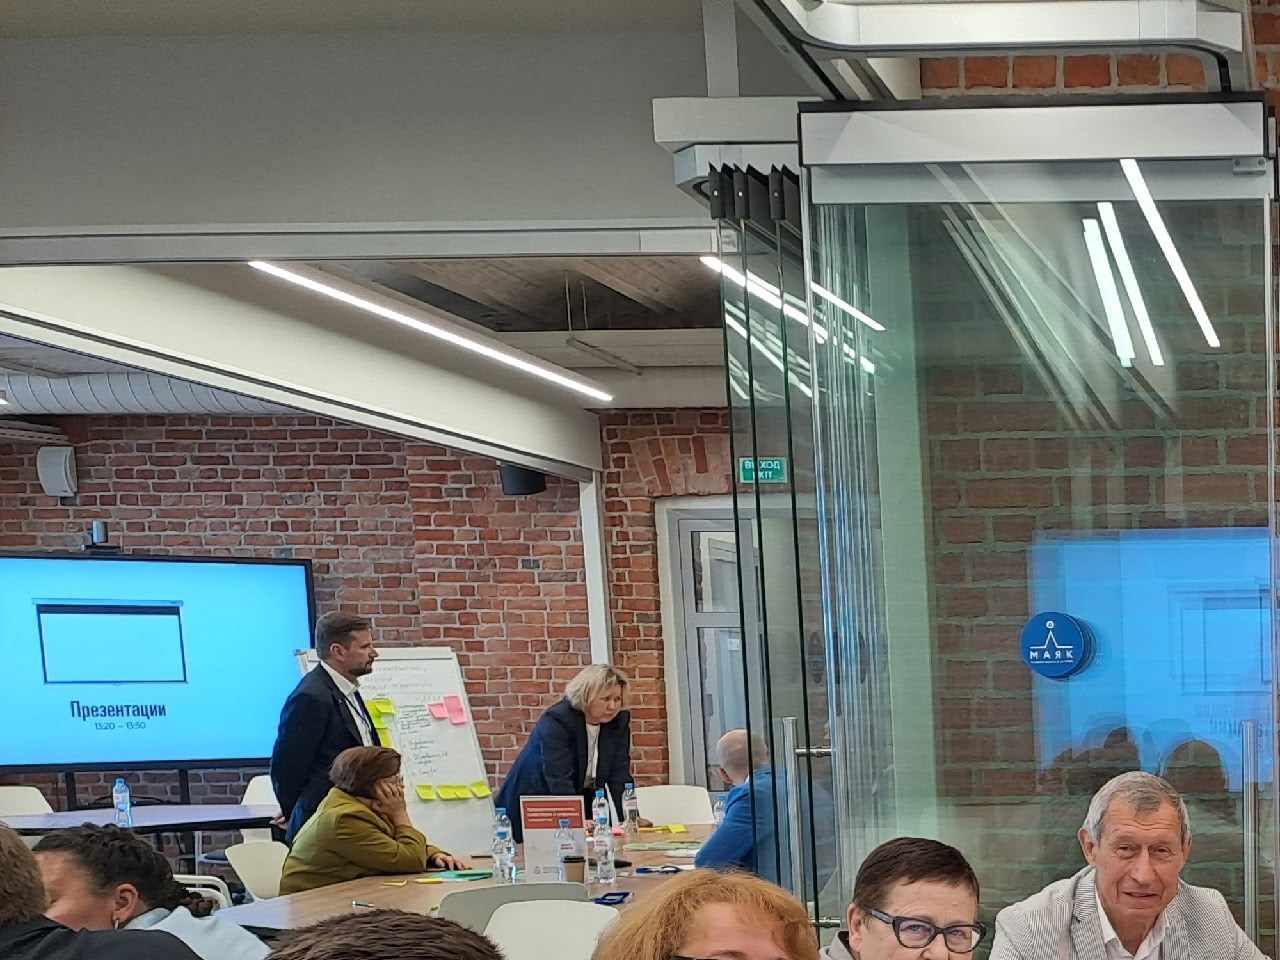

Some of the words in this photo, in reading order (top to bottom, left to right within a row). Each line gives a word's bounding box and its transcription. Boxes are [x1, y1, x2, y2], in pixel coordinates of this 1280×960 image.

[1030, 650, 1073, 660] МАЯК
[71, 701, 167, 721] Презентации
[94, 722, 116, 730] 13:20
[126, 721, 146, 729] 13:50
